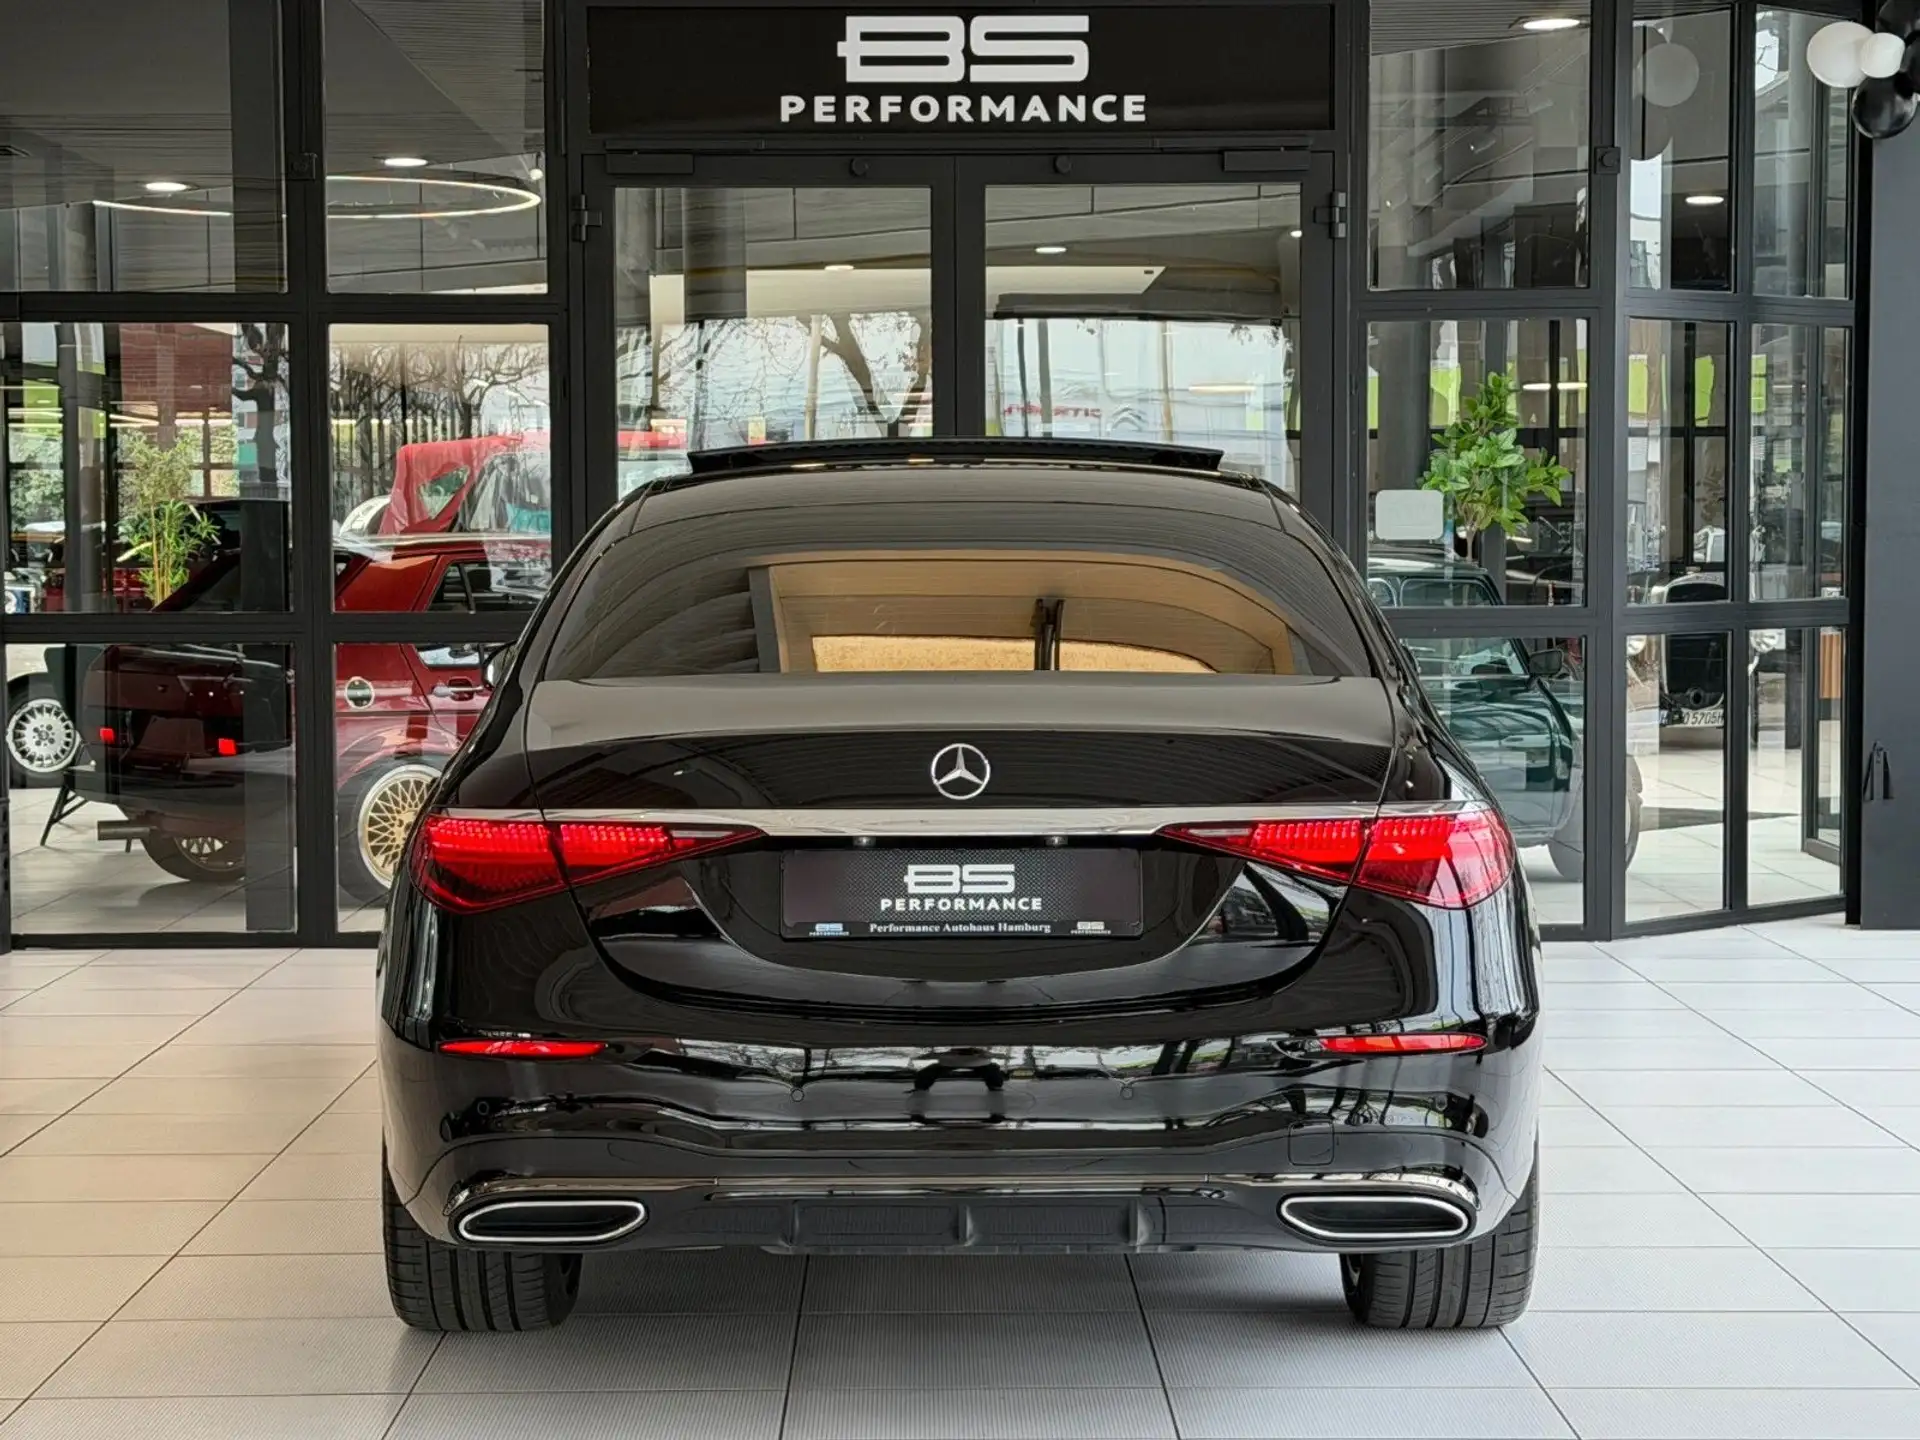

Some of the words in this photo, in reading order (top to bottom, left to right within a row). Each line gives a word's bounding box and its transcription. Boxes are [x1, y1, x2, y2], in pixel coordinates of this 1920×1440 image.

[837, 15, 1089, 82] BS
[780, 95, 1146, 123] PERFORMANCE
[903, 864, 1015, 894] BS
[880, 898, 1042, 911] PERFORMANCE
[869, 923, 940, 933] Performance
[942, 923, 995, 933] Autohaus
[998, 922, 1051, 934] Hamburg
